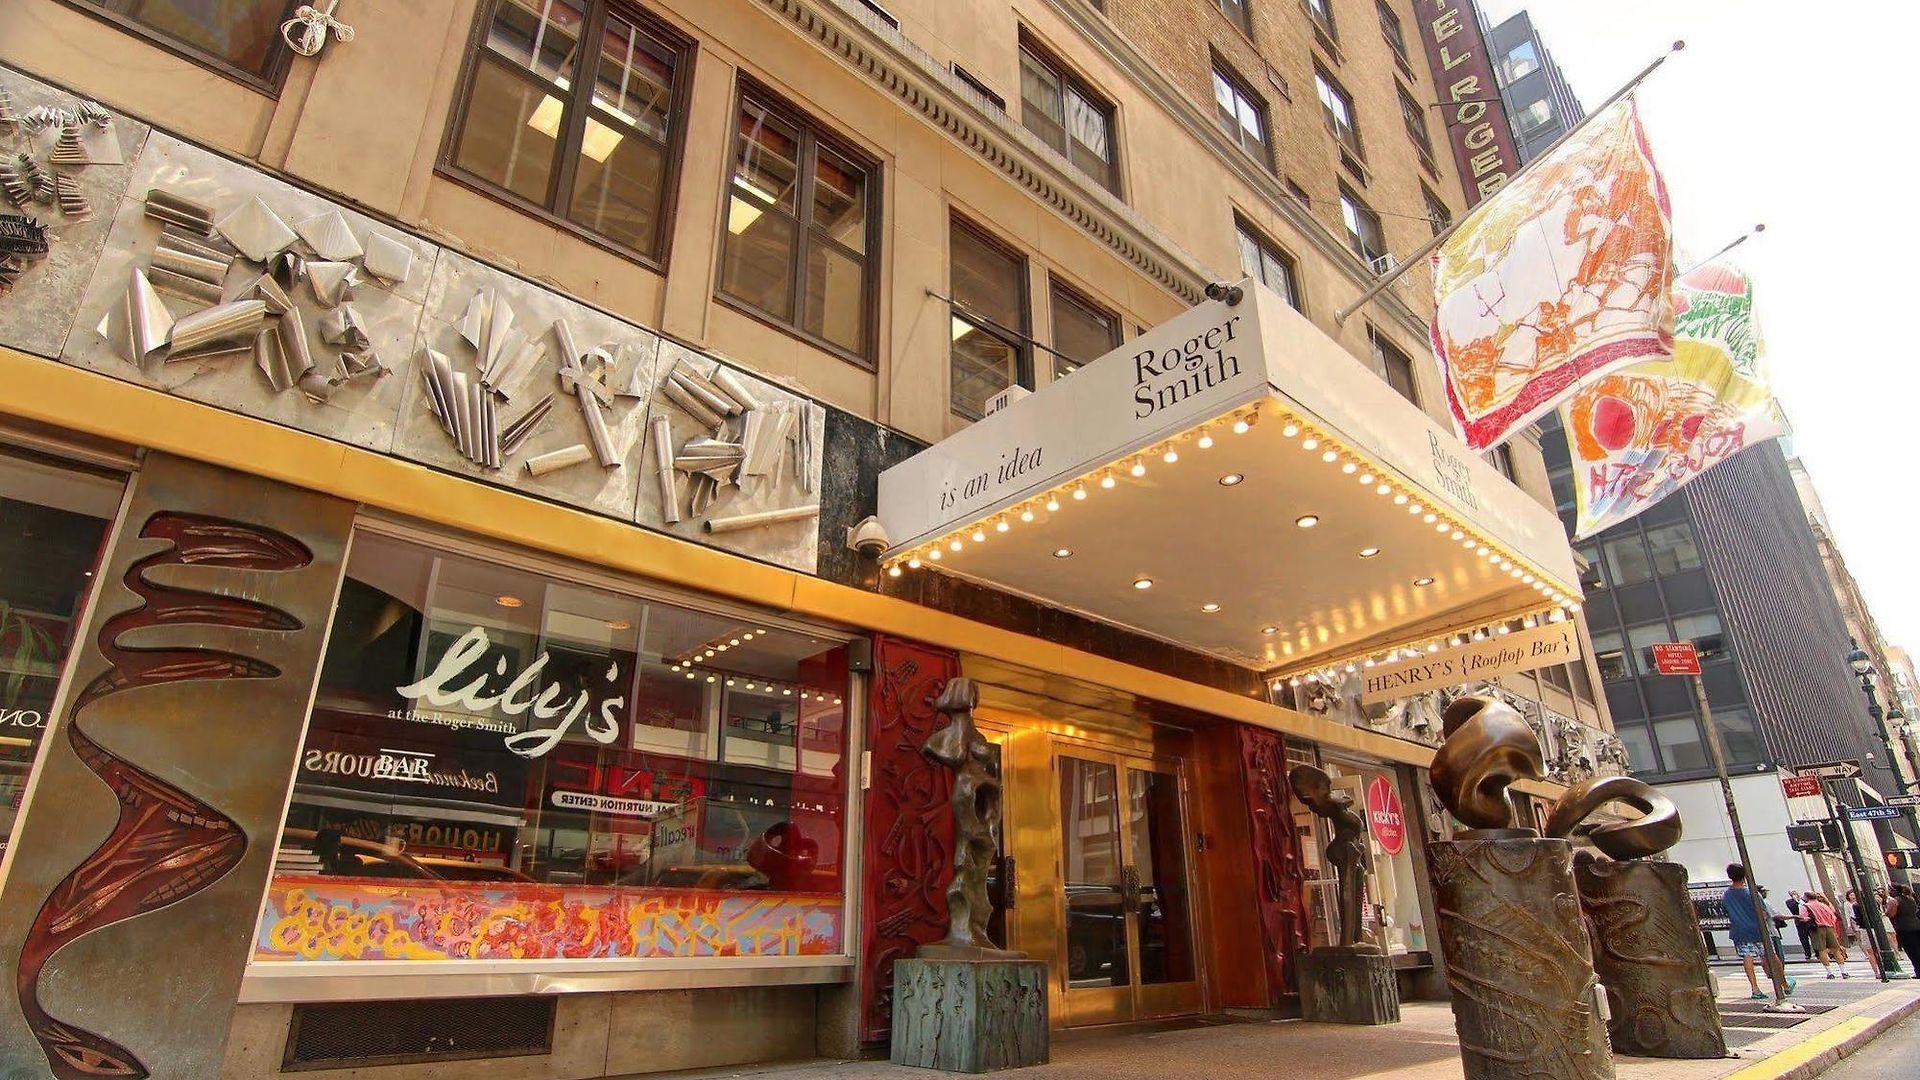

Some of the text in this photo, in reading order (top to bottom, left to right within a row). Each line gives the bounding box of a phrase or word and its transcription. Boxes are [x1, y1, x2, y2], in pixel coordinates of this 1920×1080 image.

[1133, 316, 1241, 387] Roger
[1134, 350, 1242, 420] Smith
[940, 447, 1043, 511] is an idea
[1427, 429, 1471, 482] Roger
[1433, 458, 1478, 511] Smith
[1367, 659, 1454, 693] HENRY'S
[387, 708, 517, 735] at the Roger Smith
[378, 754, 430, 777] BAR
[1833, 765, 1853, 774] WAY
